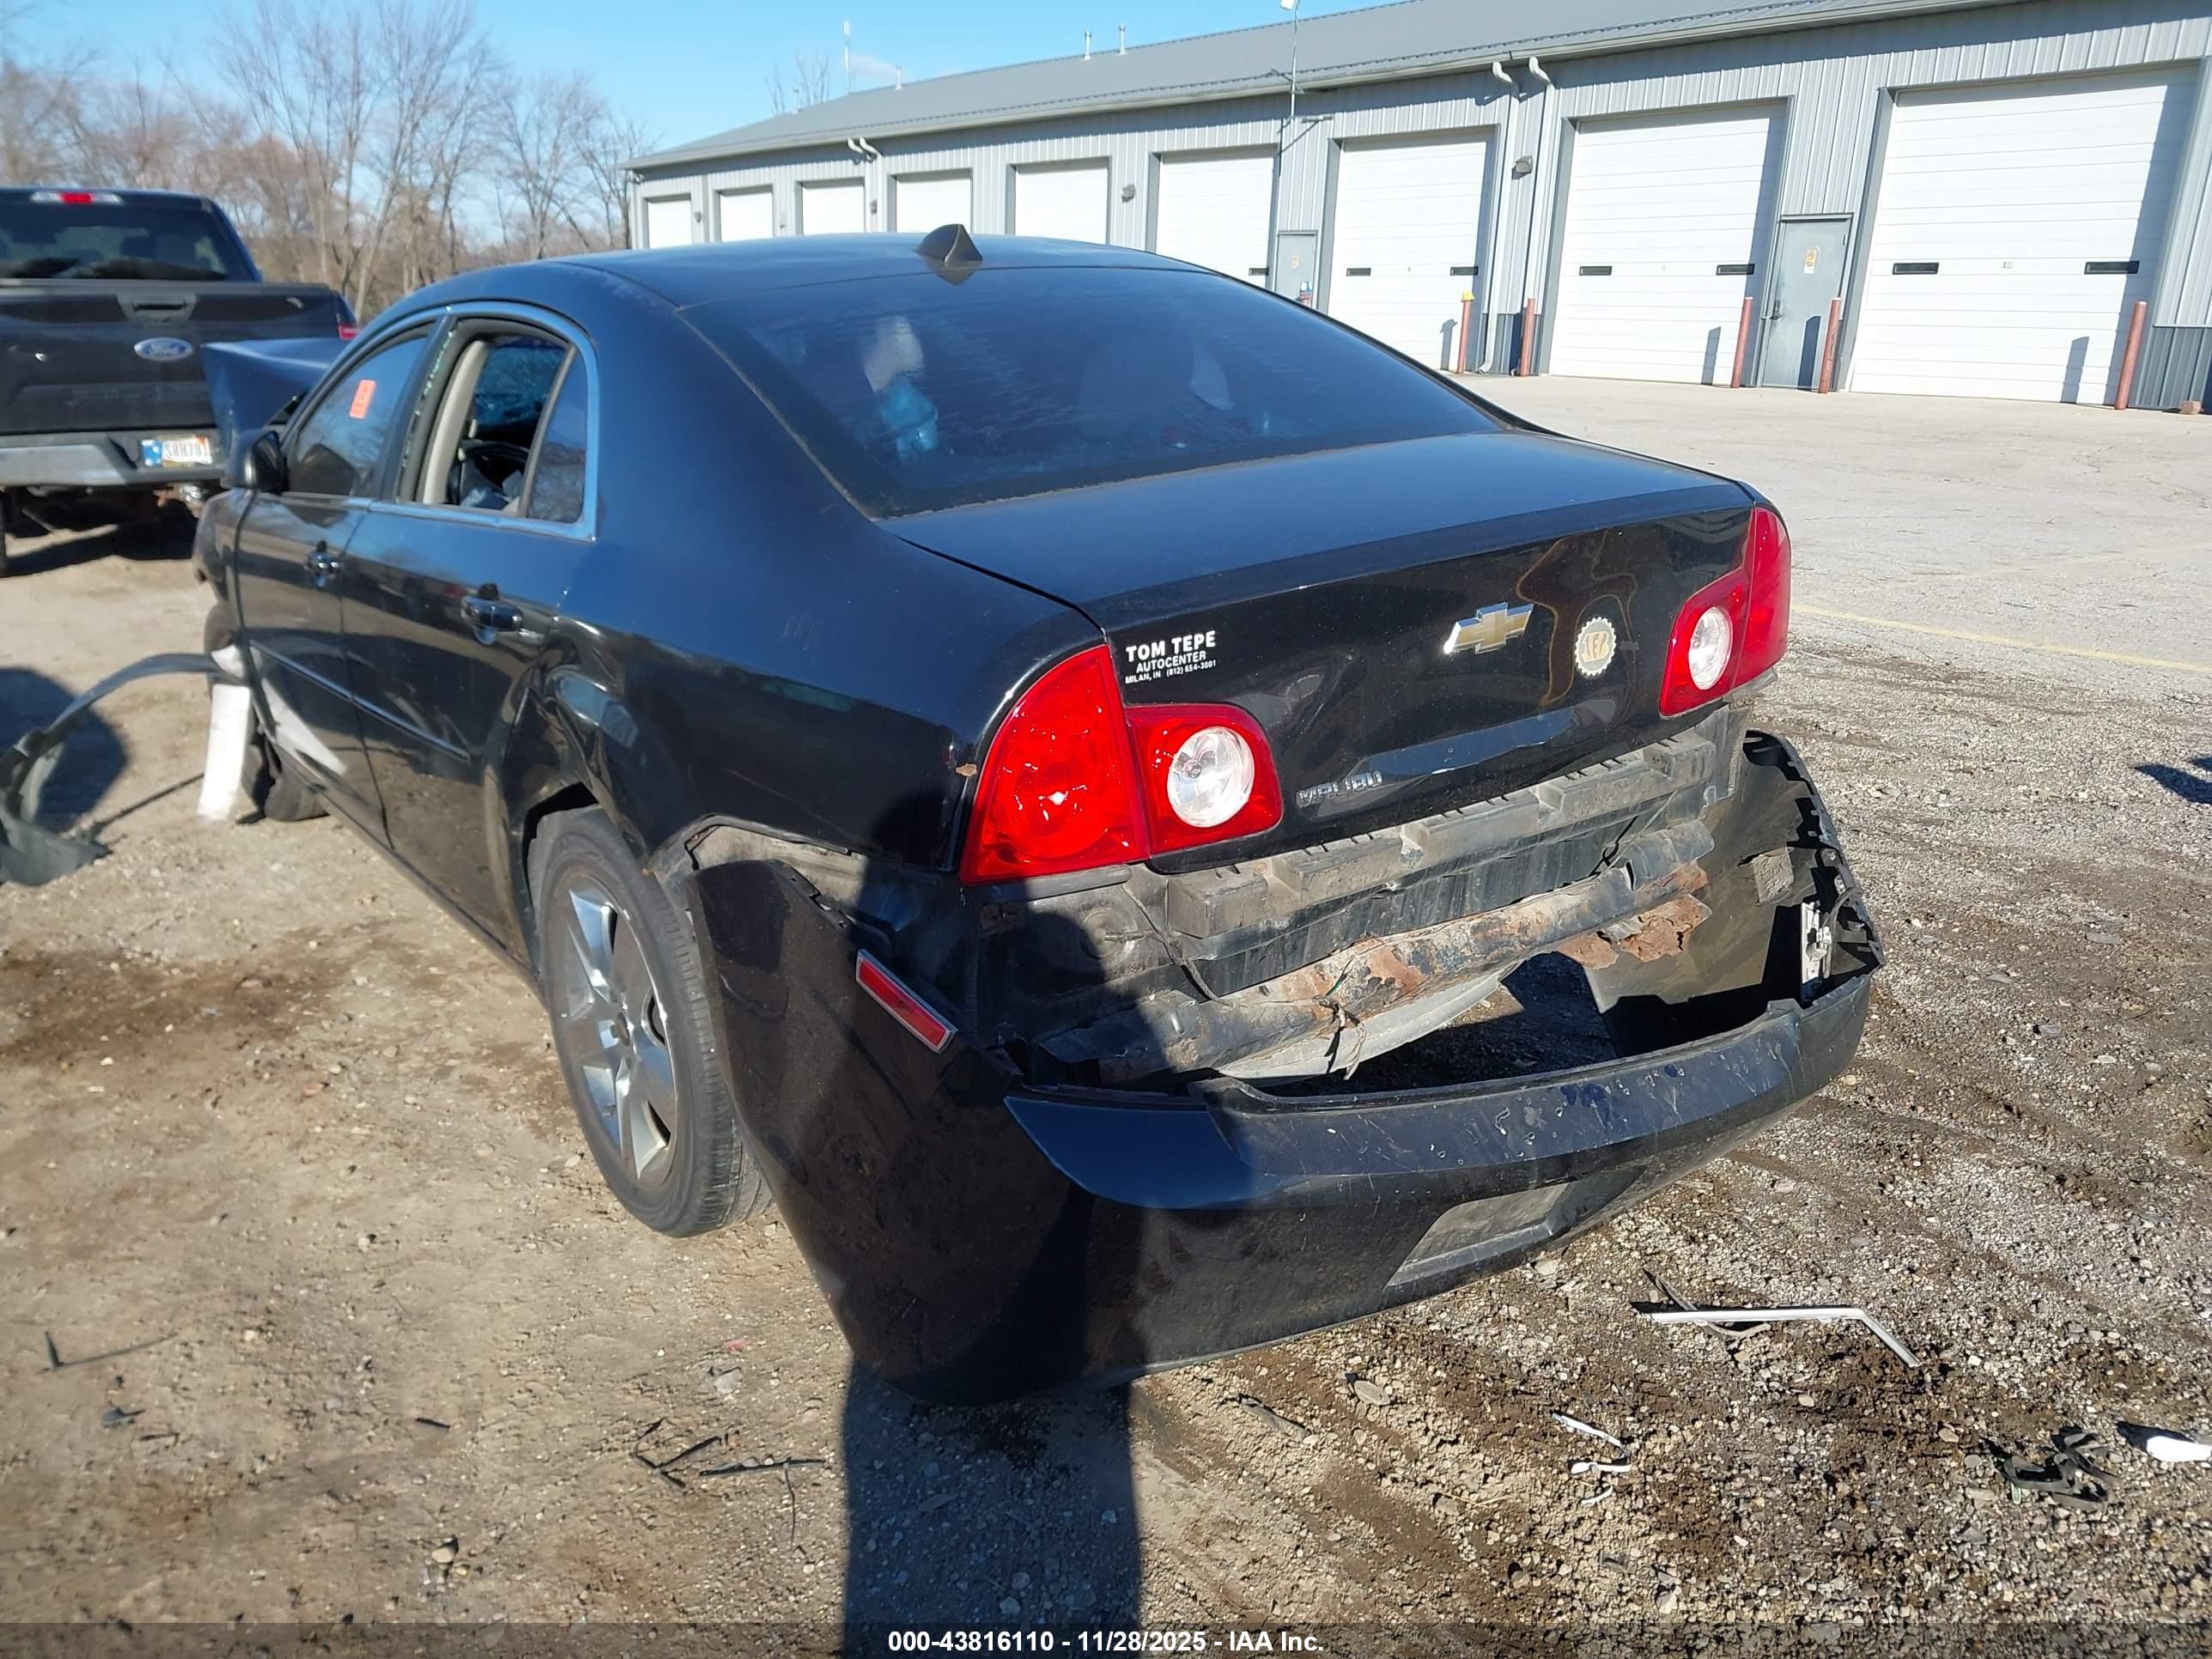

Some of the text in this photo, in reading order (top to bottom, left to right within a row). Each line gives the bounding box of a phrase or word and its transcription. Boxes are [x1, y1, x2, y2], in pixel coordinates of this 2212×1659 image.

[1125, 630, 1216, 662] TOM TEPE
[1136, 650, 1206, 673] AUTOCENTER
[1125, 673, 1152, 684] MILAN,
[1152, 671, 1161, 679] IN
[1166, 667, 1183, 678] (812)
[1296, 770, 1382, 808] MALIBU
